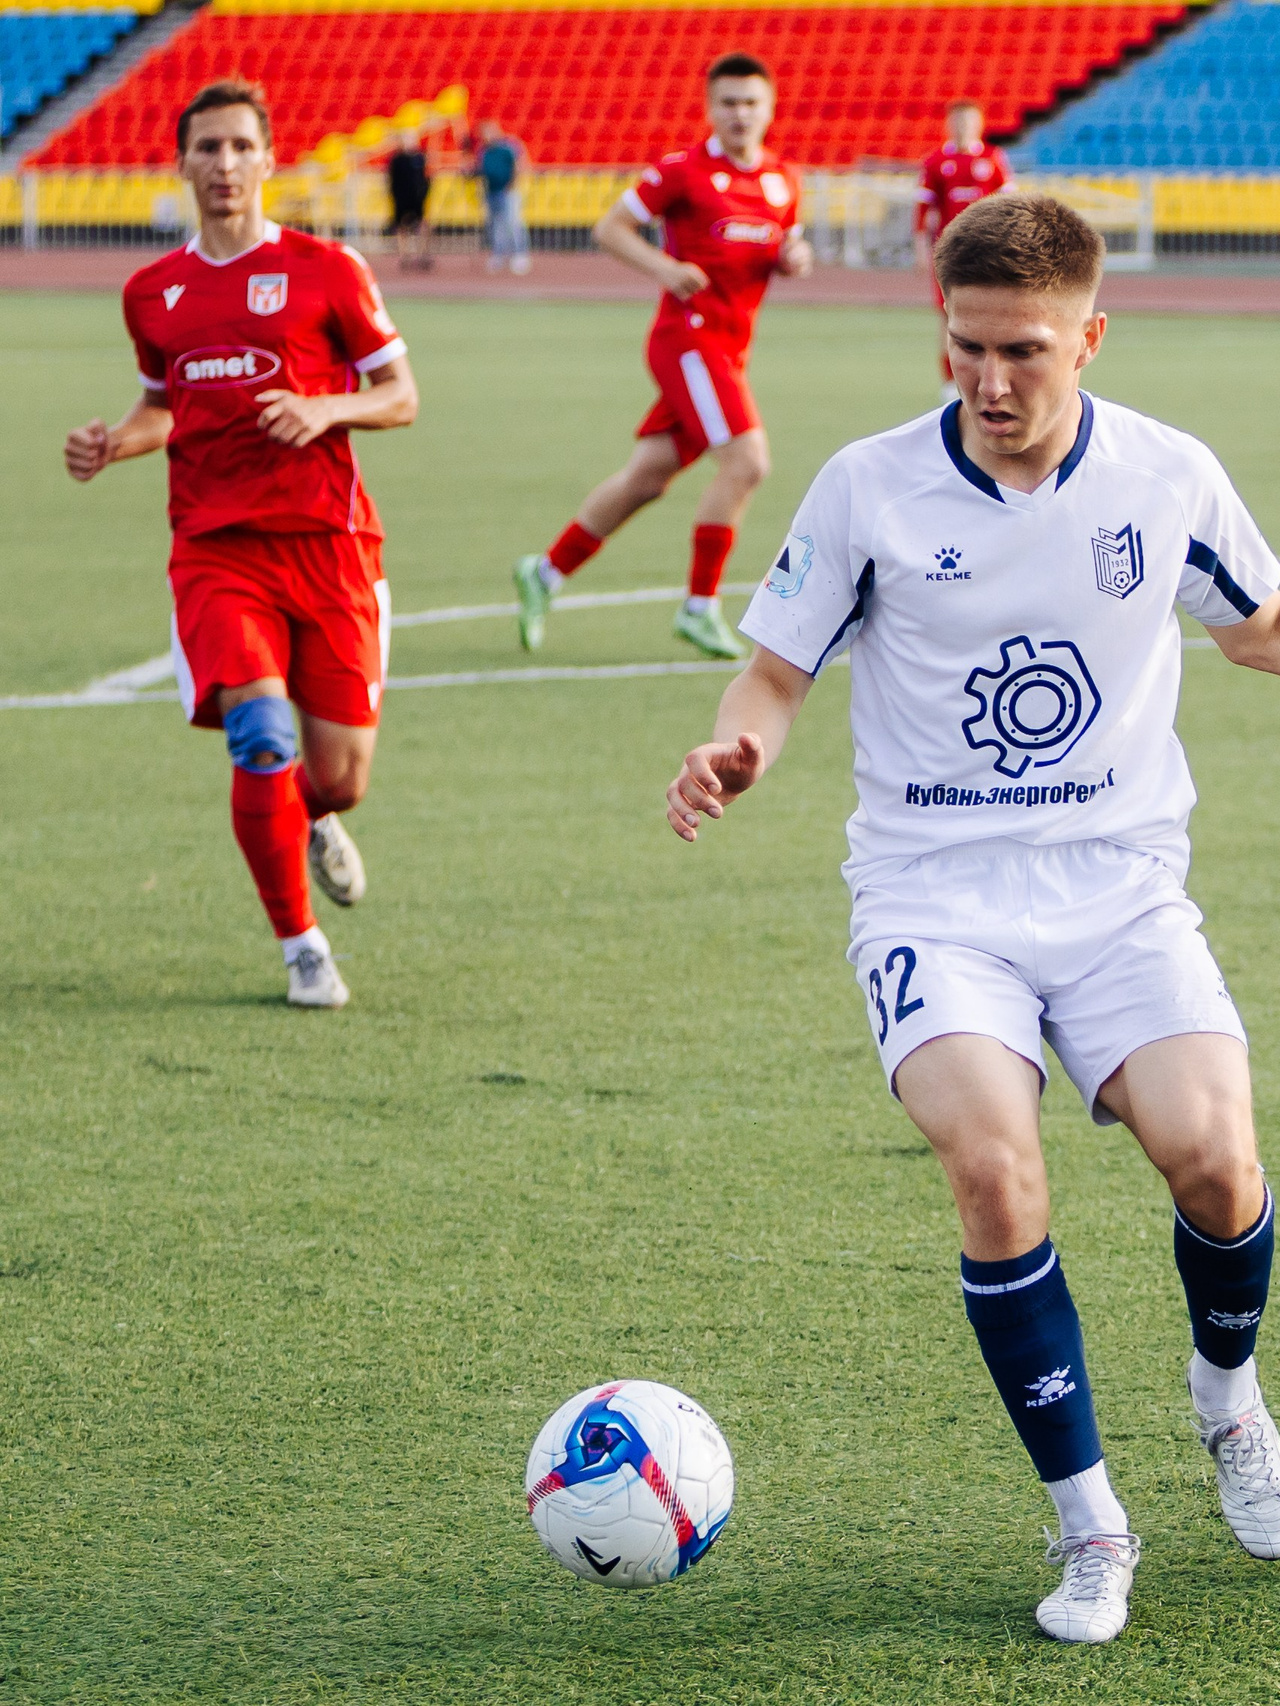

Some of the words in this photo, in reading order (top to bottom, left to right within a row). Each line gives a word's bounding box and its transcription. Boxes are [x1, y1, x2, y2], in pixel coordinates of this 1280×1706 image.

[184, 352, 256, 382] amet
[926, 571, 972, 581] KELME
[1111, 558, 1129, 568] 1932
[869, 946, 925, 1046] 32
[1026, 1381, 1076, 1408] KELME
